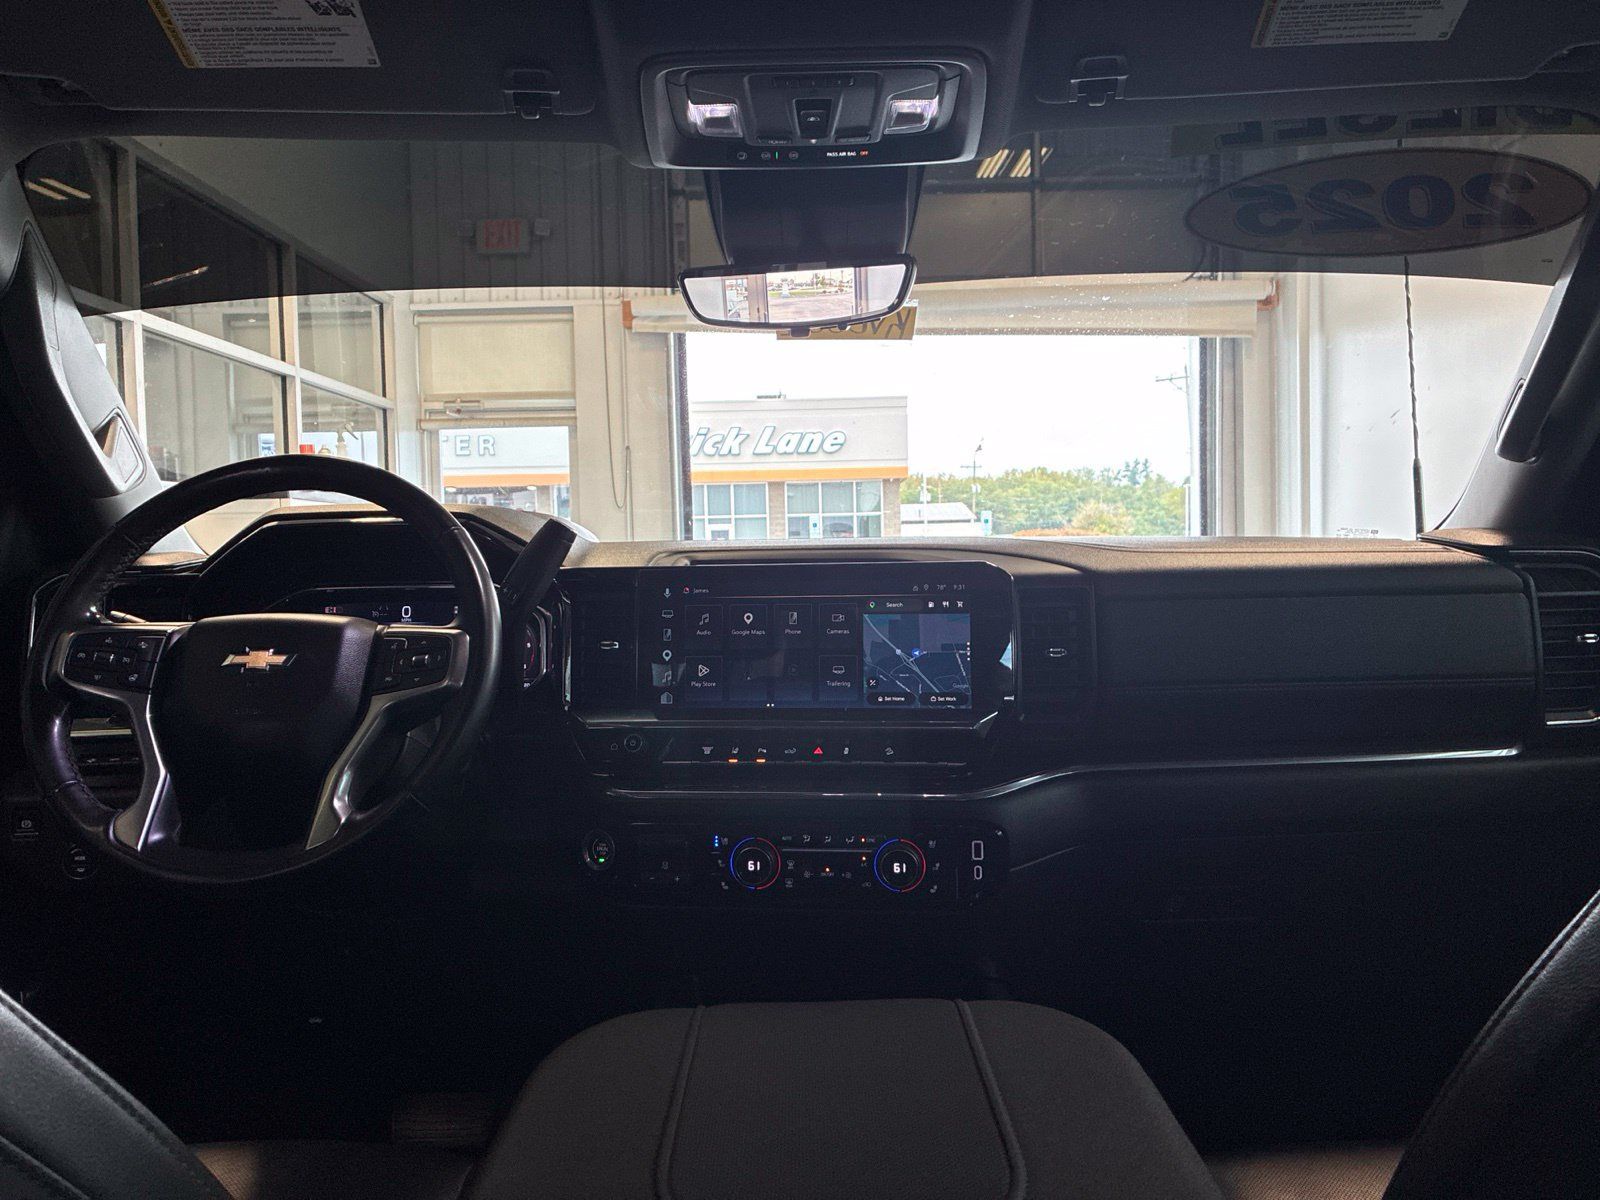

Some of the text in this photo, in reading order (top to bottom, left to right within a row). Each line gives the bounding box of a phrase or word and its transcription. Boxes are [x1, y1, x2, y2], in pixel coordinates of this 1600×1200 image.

[442, 434, 497, 456] ER
[690, 425, 847, 456] ick Lane
[401, 605, 412, 618] 0
[731, 629, 750, 637] Google
[826, 680, 851, 688] Trailering
[747, 860, 761, 871] 61
[893, 863, 906, 873] 61
